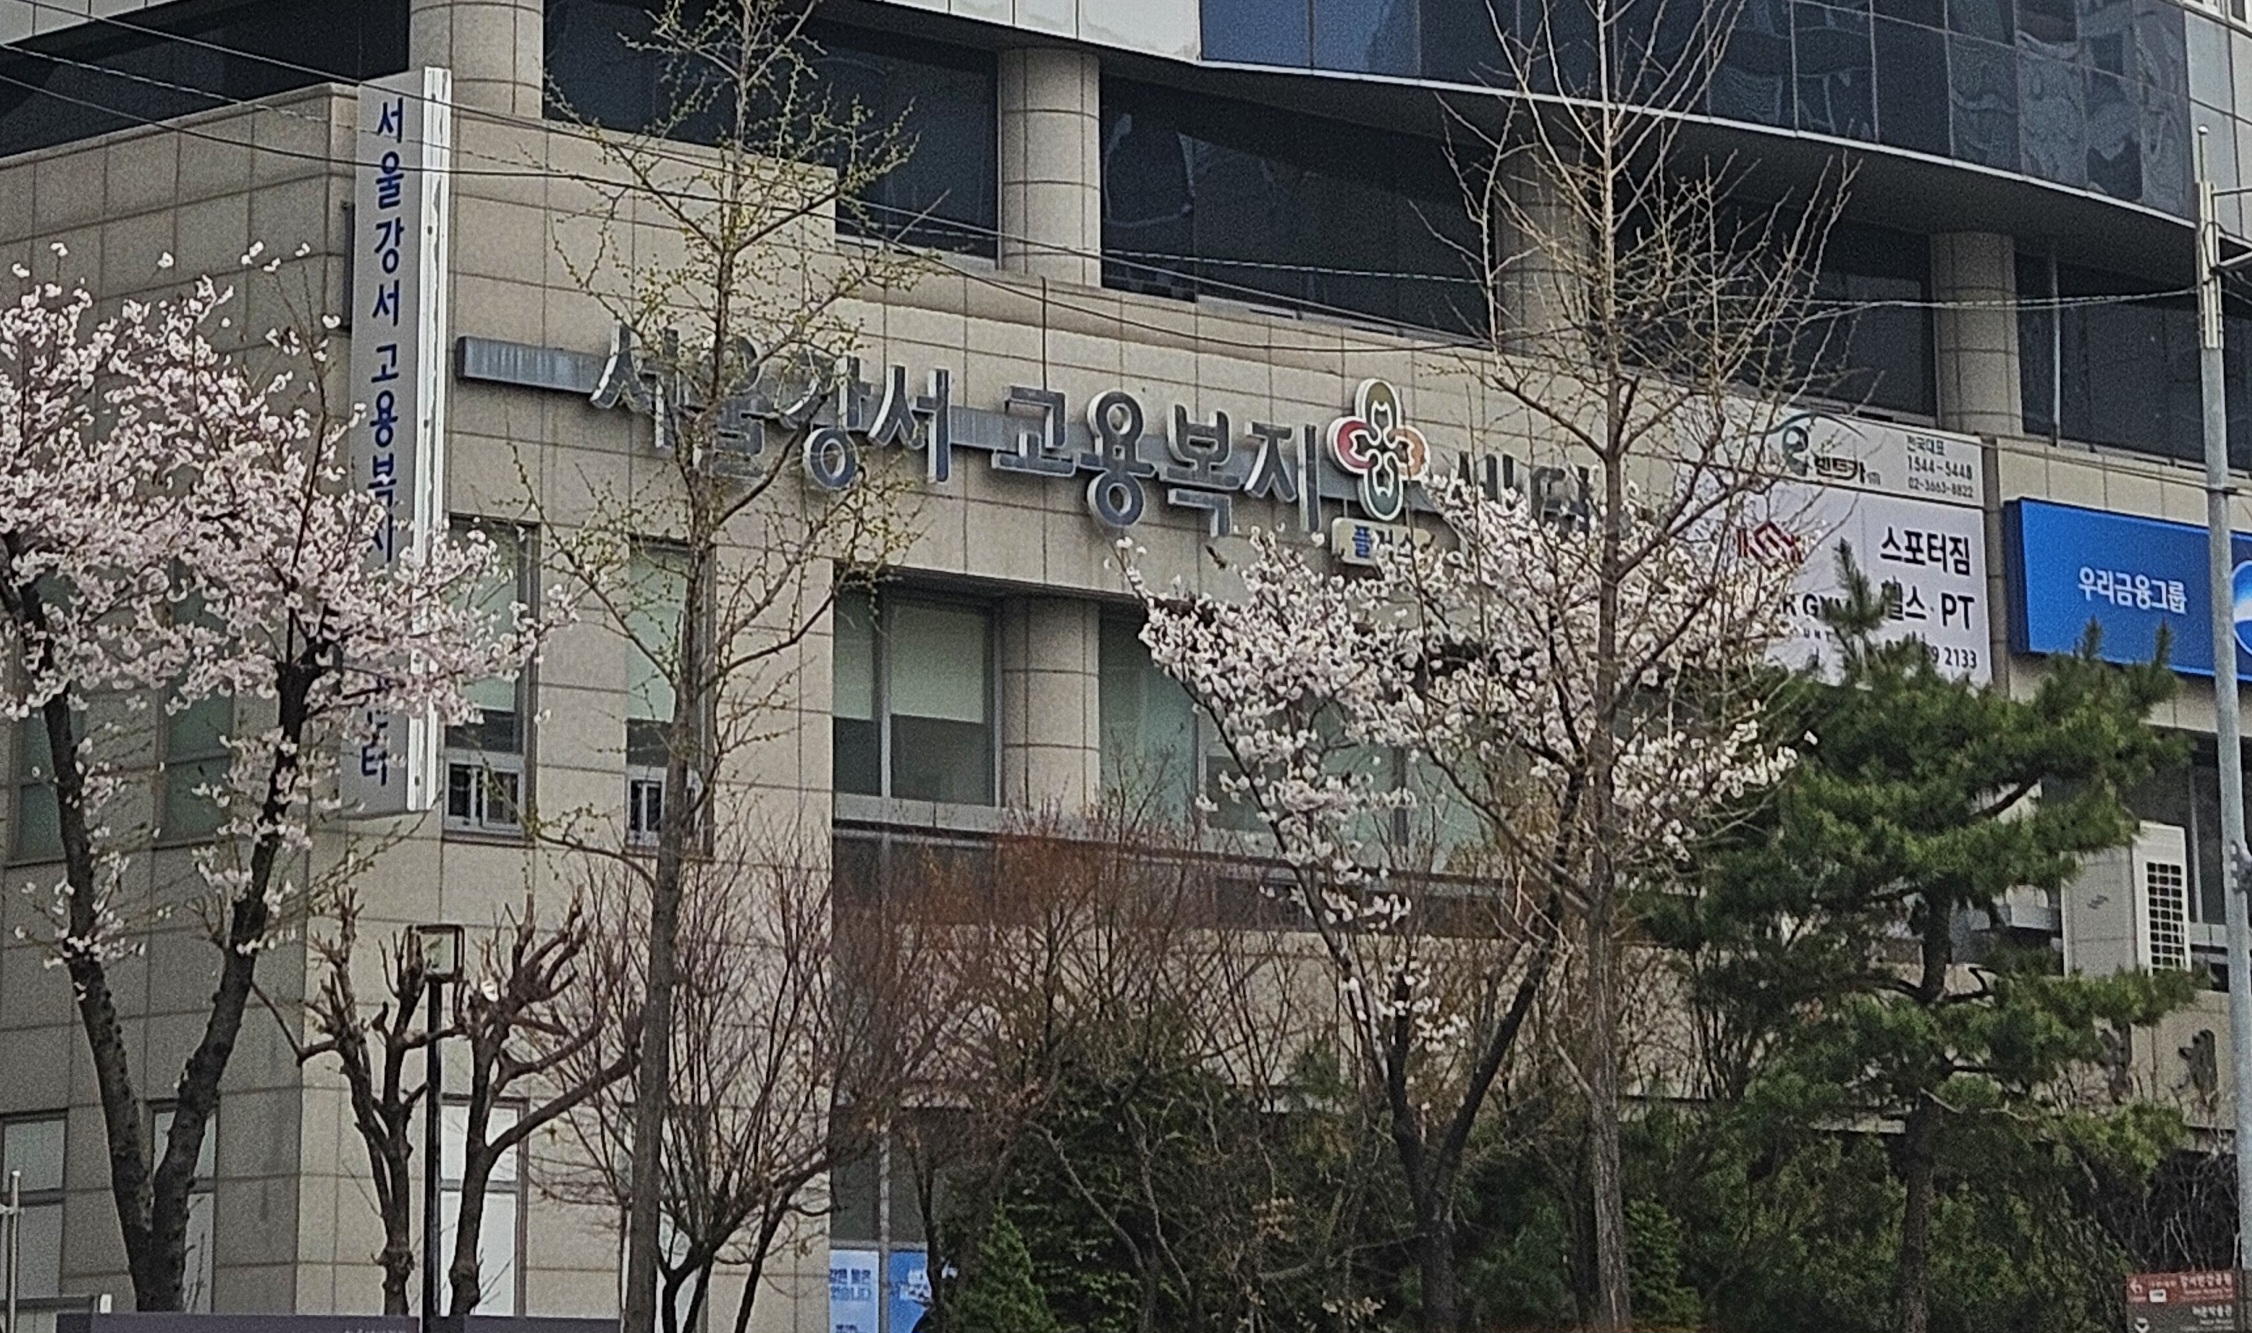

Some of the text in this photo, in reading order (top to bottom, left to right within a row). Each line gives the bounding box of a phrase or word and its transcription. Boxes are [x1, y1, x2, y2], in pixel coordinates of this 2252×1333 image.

[372, 96, 404, 327] 서울강서
[590, 324, 951, 490] 서울강서
[991, 386, 1322, 537] 고용복지
[1907, 455, 1973, 480] 1544-5448
[1880, 526, 1970, 577] 스포터짐
[2078, 566, 2188, 616] 우리금융그룹
